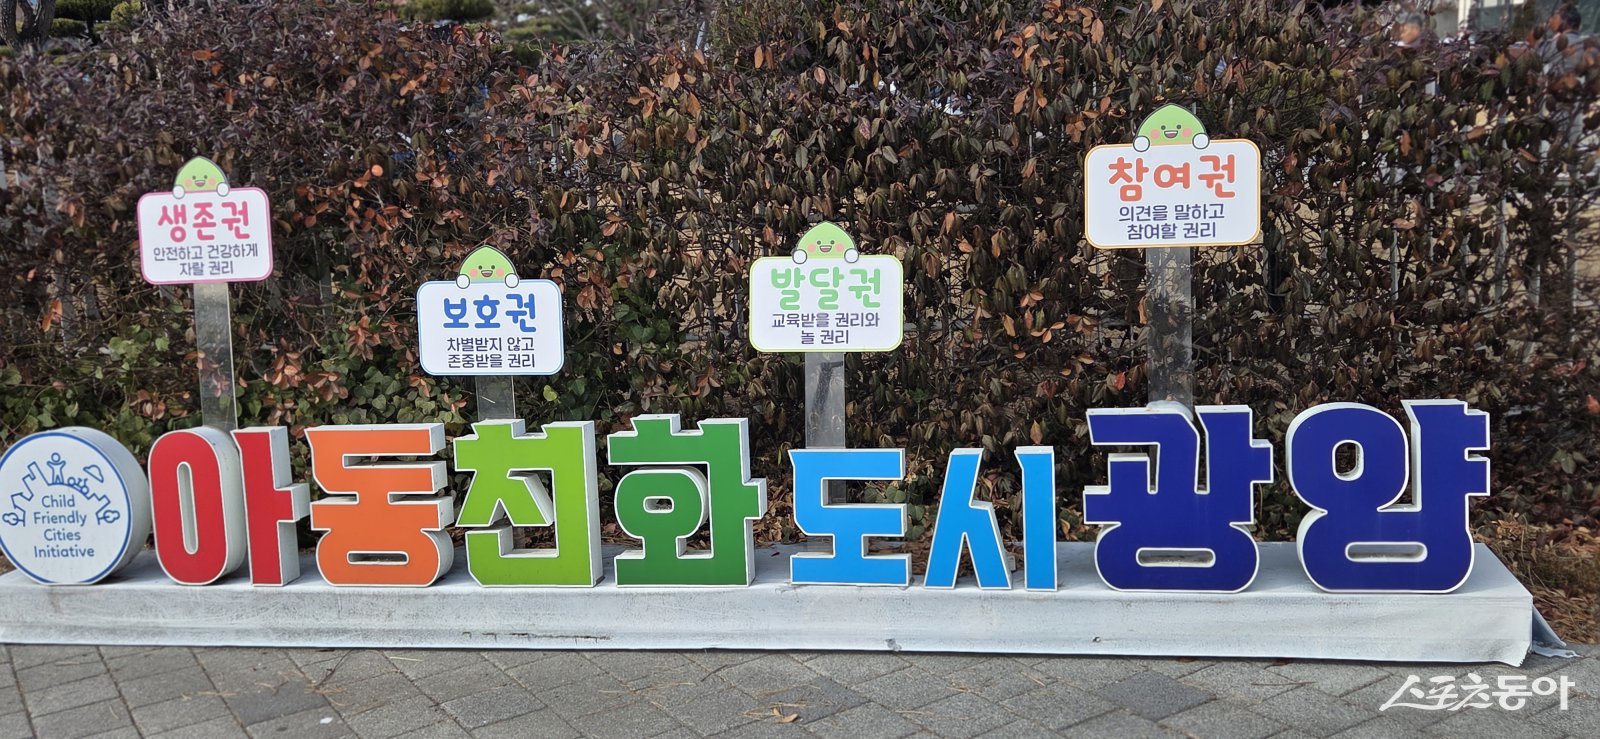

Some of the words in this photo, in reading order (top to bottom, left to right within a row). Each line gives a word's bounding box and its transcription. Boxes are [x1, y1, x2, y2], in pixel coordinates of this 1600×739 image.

[1109, 154, 1235, 201] 참여권
[1119, 205, 1168, 222] 의견을
[1175, 204, 1224, 220] 말하고
[158, 201, 250, 242] 생존권
[1127, 223, 1178, 240] 참여할
[1183, 222, 1215, 238] 권리
[154, 246, 203, 261] 안전하고
[208, 243, 258, 259] 건강하게
[180, 262, 204, 276] 자랄
[209, 261, 233, 275] 권리
[771, 267, 880, 310] 발달권
[443, 293, 536, 332] 보호권
[772, 313, 829, 328] 교육받을
[835, 312, 880, 327] 권리와
[447, 337, 502, 352] 차별받지
[507, 337, 534, 351] 않고
[801, 330, 815, 344] 놀
[820, 330, 848, 344] 권리
[448, 354, 503, 368] 존중받을
[507, 354, 535, 368] 권리
[42, 495, 75, 508] Child
[1083, 398, 1491, 593] 광양
[34, 511, 87, 526] Friendly
[44, 529, 82, 541] Cities
[34, 544, 94, 557] Initiative
